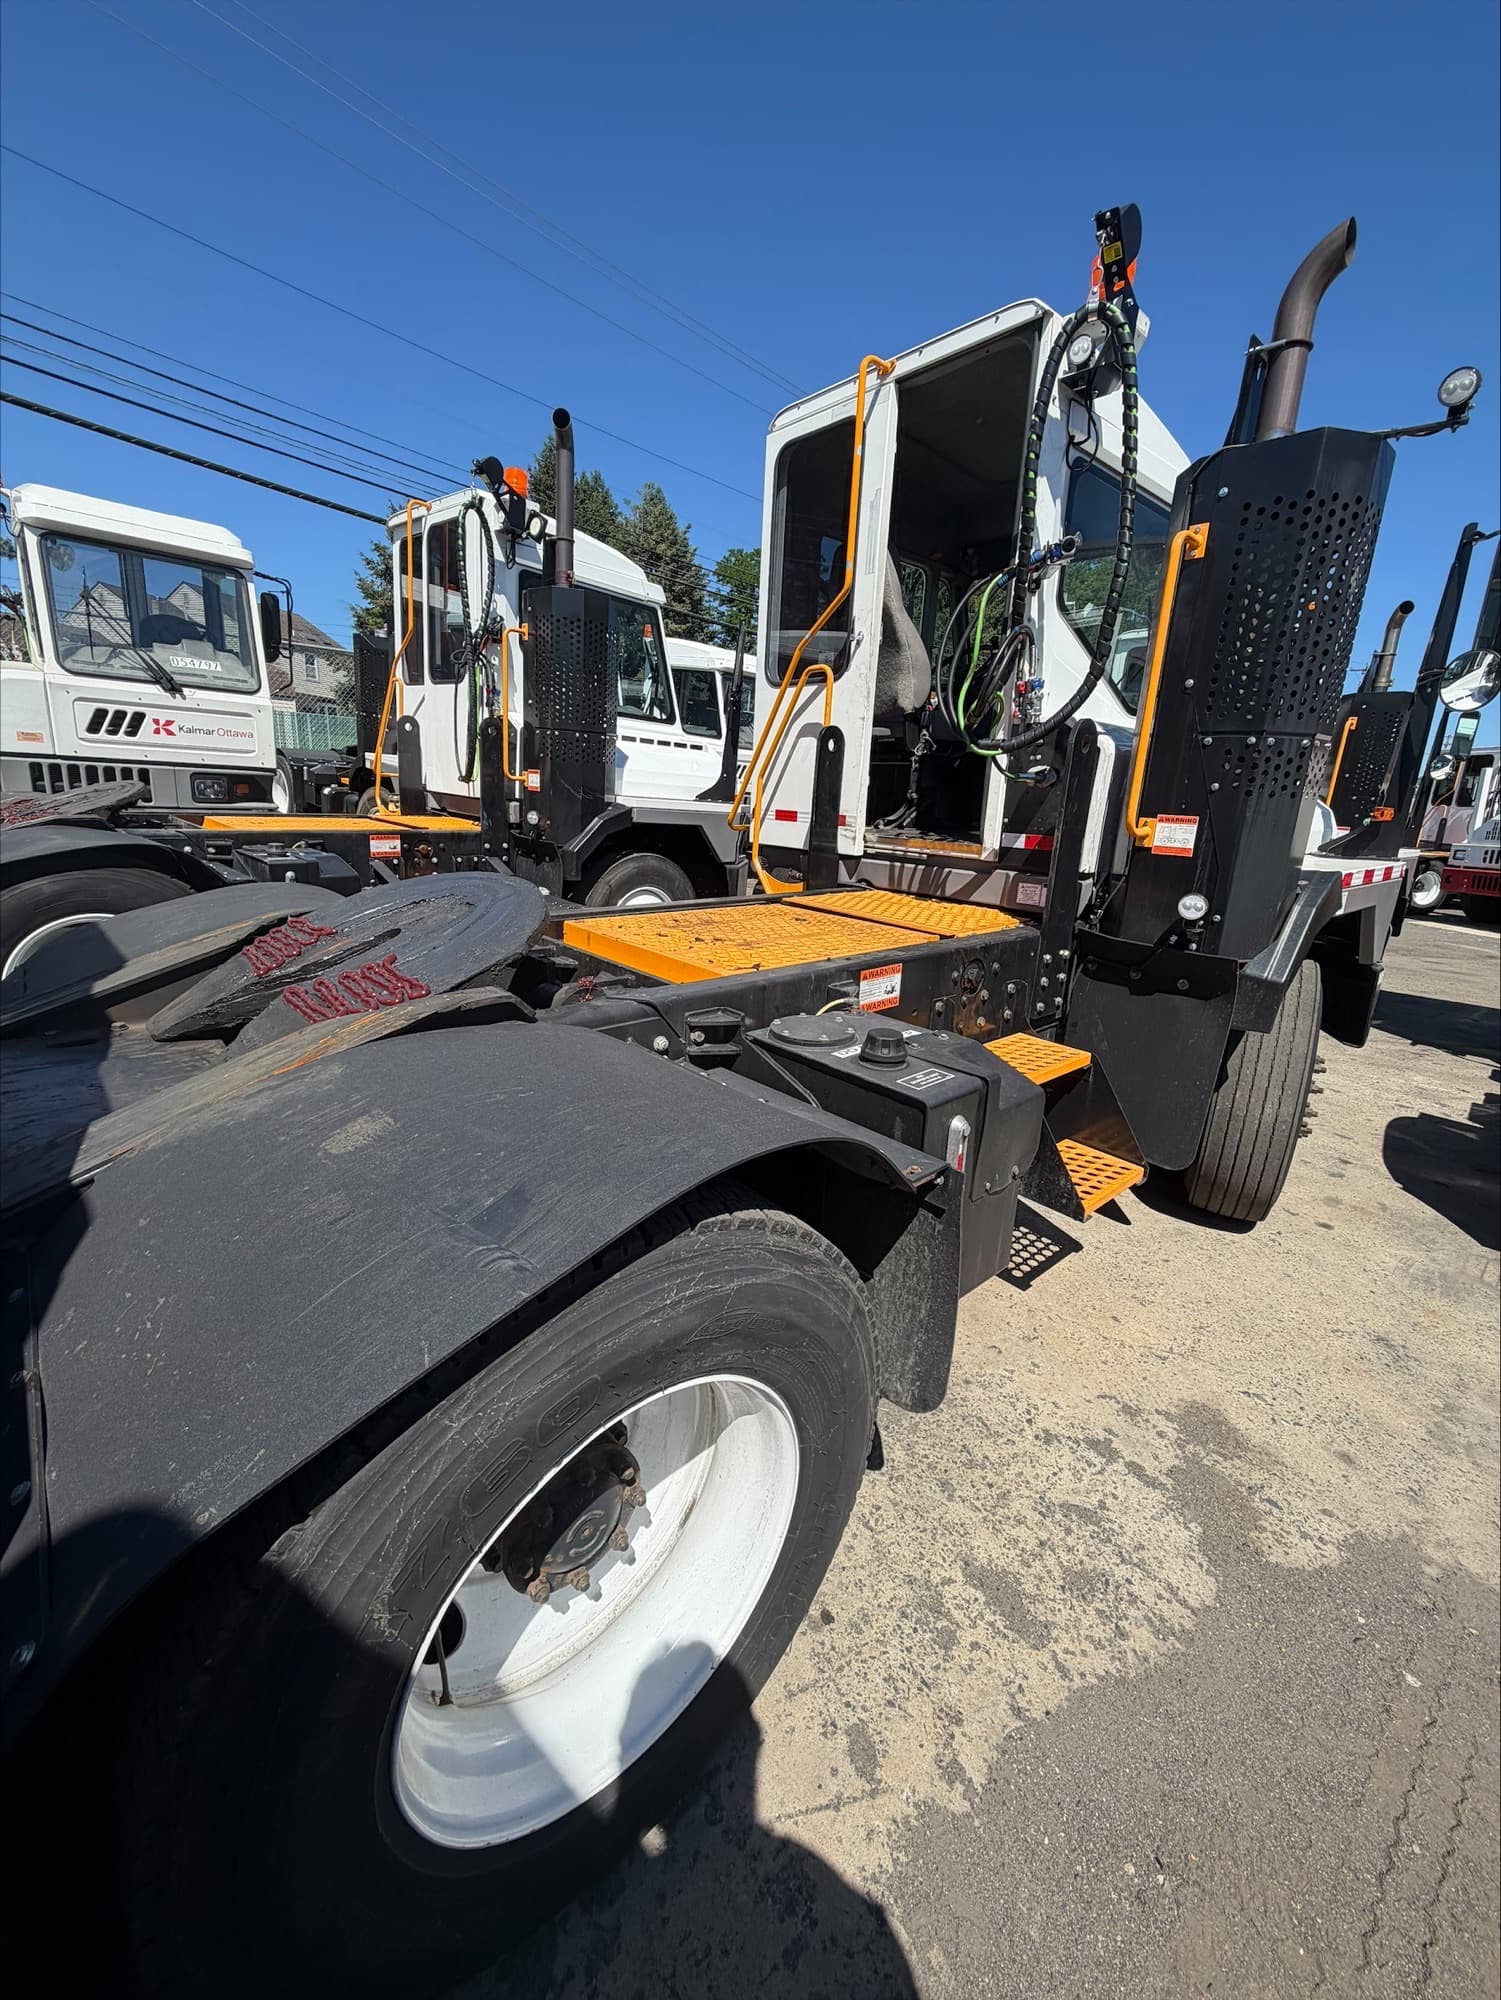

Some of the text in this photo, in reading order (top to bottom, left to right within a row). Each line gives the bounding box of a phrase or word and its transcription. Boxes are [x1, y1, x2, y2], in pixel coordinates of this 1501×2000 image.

[178, 724, 215, 736] Kalmar
[217, 727, 254, 739] Ottawa
[868, 964, 901, 979] WARNING
[865, 996, 899, 1011] WARNING
